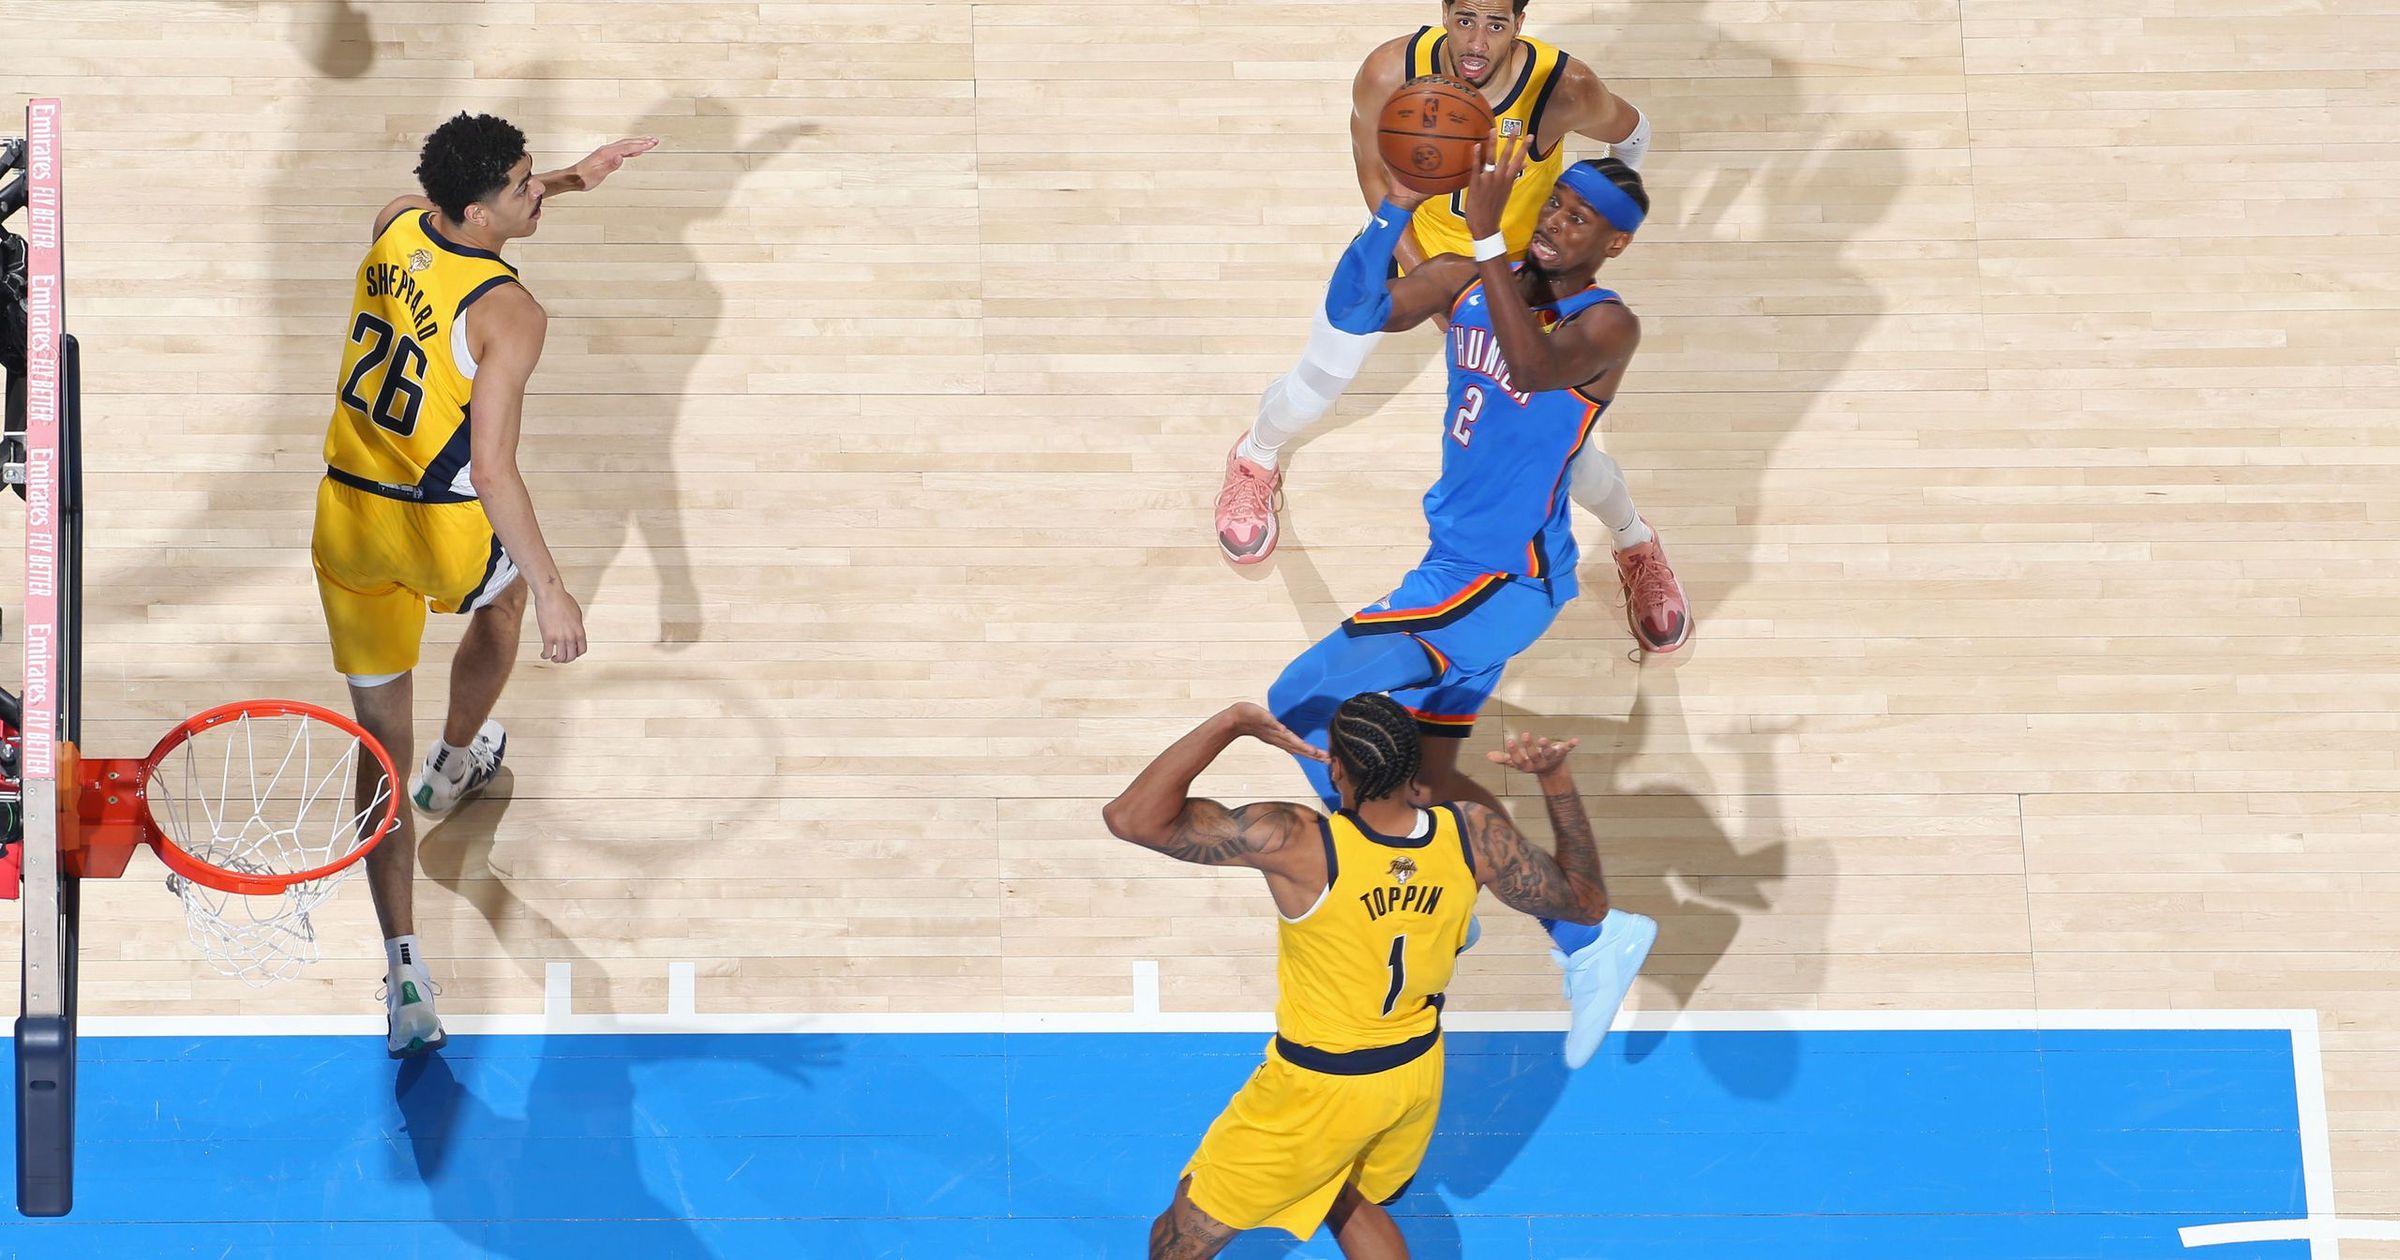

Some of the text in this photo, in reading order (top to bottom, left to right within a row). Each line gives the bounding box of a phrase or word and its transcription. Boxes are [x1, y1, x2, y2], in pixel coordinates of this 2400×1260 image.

[31, 104, 56, 249] Emirates FLY BETTER
[31, 274, 56, 422] Emirates FLY BETTER
[366, 263, 438, 341] SHEPPARD
[341, 311, 428, 437] 26
[1452, 384, 1485, 447] 2
[29, 448, 54, 597] Emirates FLY BETTER
[26, 623, 52, 774] Emirates FLY BETTER
[1360, 885, 1444, 922] TOPPIN
[1381, 935, 1407, 1018] 1
